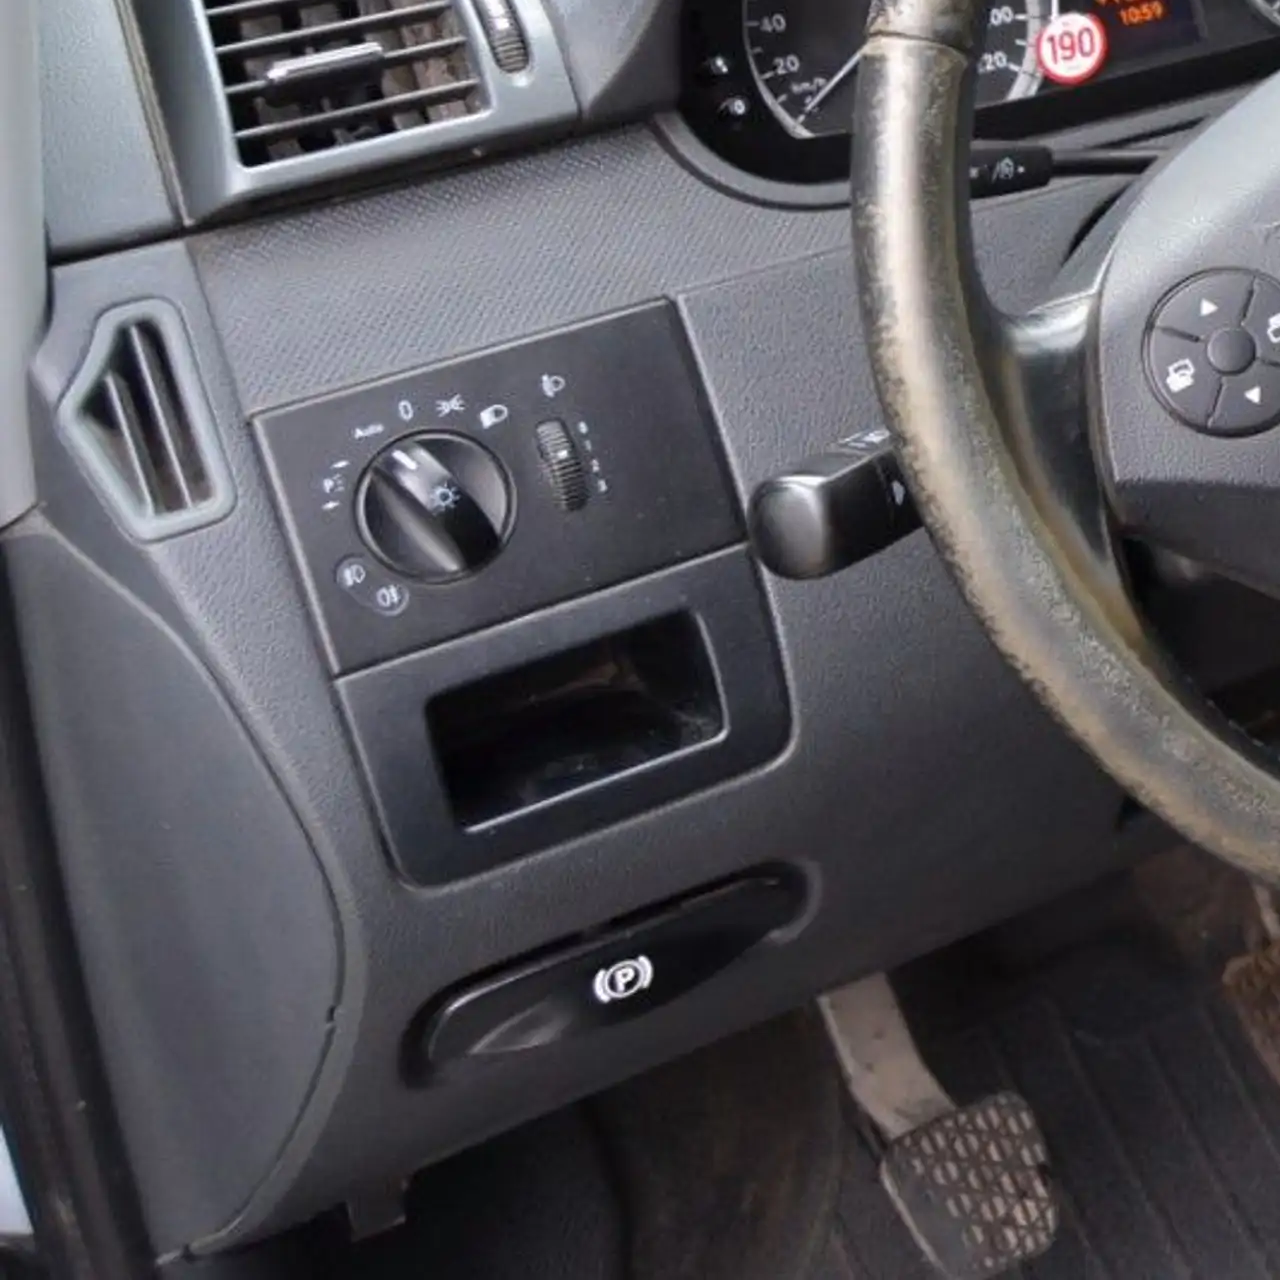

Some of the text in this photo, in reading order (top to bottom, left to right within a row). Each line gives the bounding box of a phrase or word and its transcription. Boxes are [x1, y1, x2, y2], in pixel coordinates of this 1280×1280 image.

[759, 13, 787, 32] 40
[989, 5, 1014, 26] 00
[1046, 27, 1096, 64] 190
[774, 54, 800, 75] 20
[399, 399, 413, 421] 0
